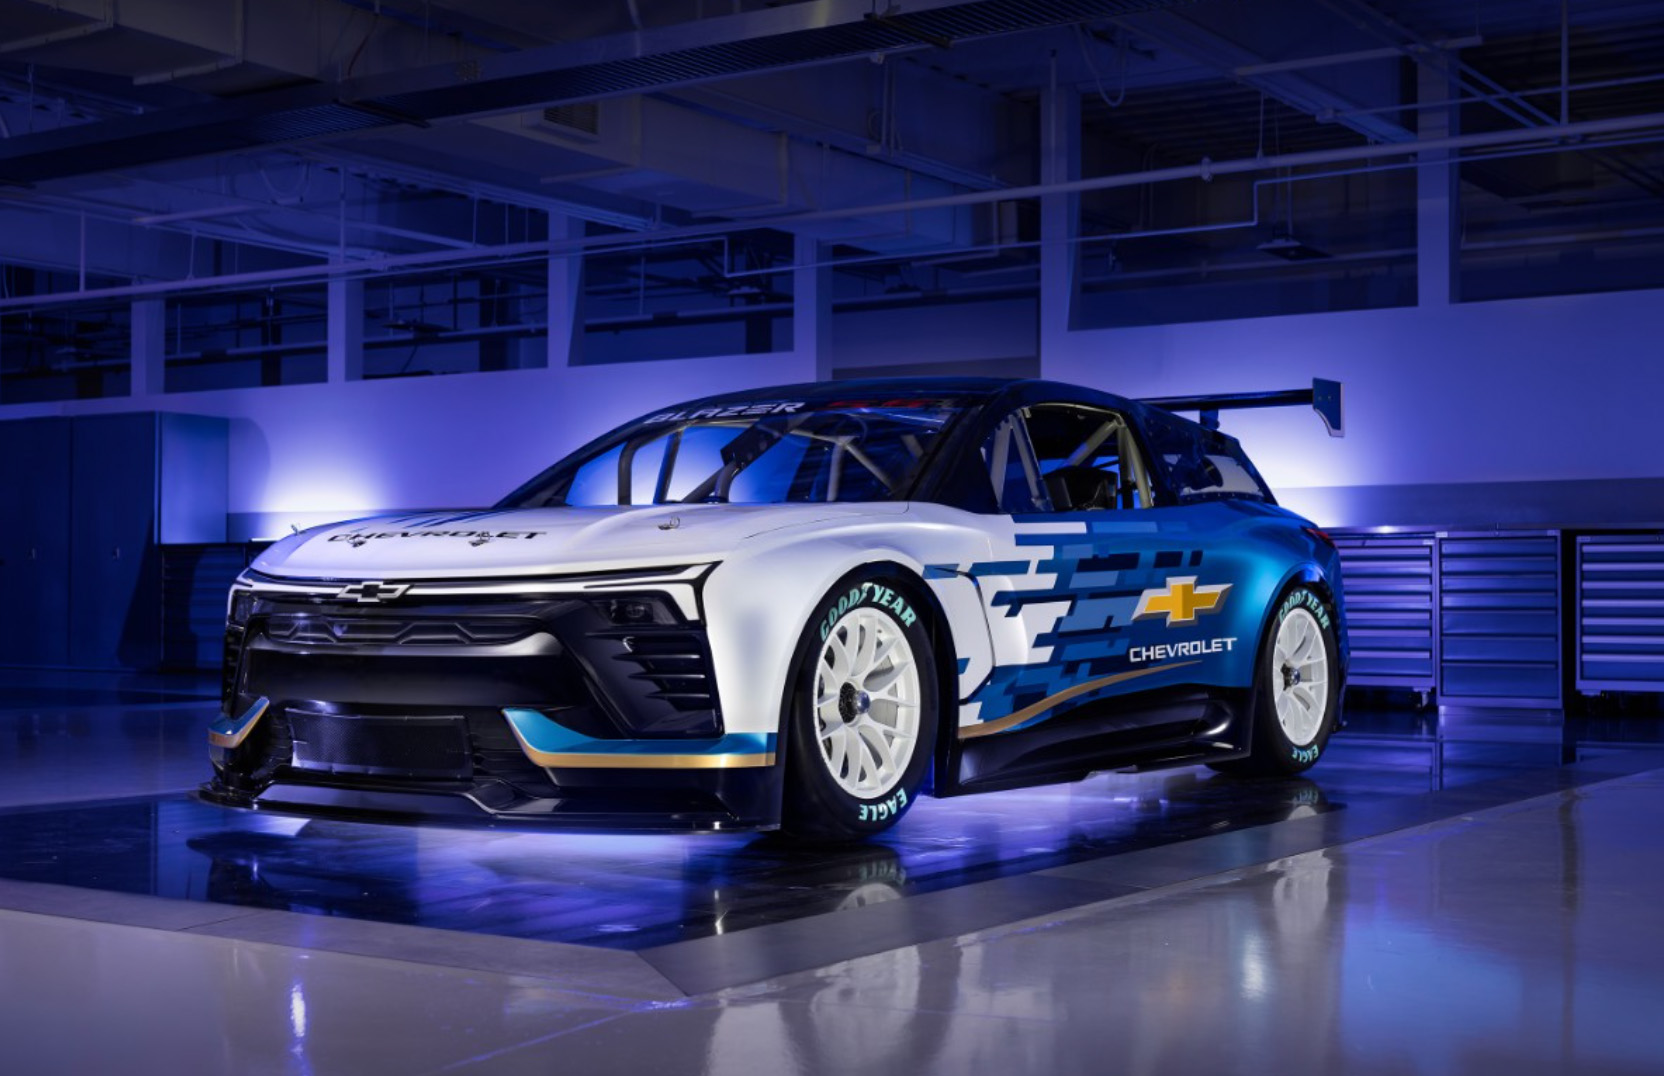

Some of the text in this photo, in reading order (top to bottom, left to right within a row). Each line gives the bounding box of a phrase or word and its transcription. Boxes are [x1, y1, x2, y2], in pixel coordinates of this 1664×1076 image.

[643, 402, 806, 424] BLAZER
[1128, 637, 1238, 663] CHEVROLET
[1291, 741, 1320, 763] EAGLE
[858, 786, 909, 822] EAGLE
